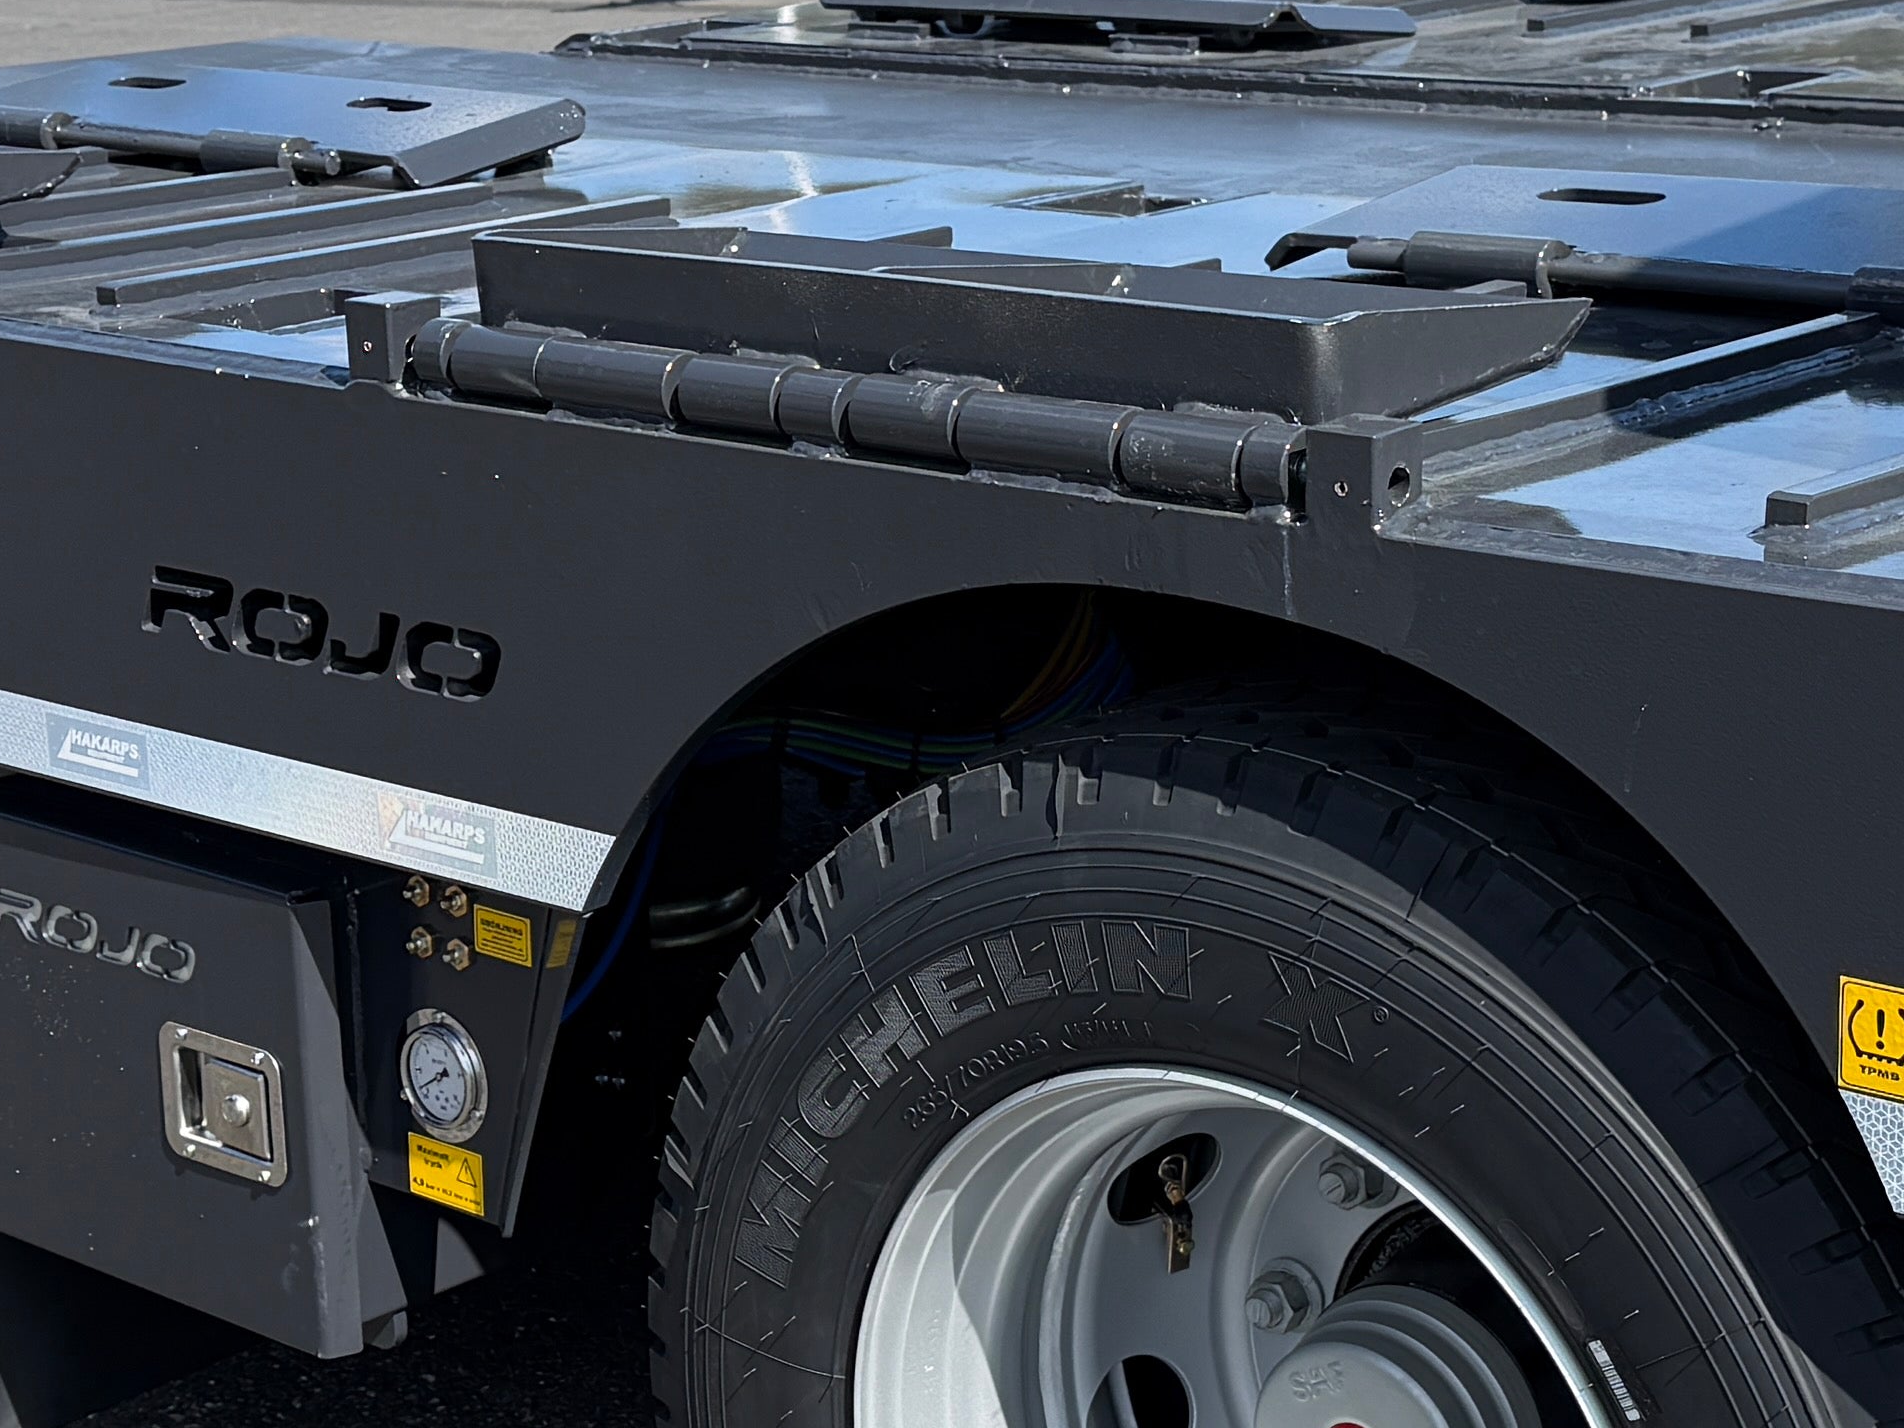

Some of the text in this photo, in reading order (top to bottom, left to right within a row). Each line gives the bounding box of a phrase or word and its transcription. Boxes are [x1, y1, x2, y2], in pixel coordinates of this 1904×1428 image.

[141, 565, 501, 702] ROJO
[71, 728, 139, 760] HAKARPS
[406, 809, 486, 845] HAKARPS
[734, 920, 1193, 1289] MICHELIN
